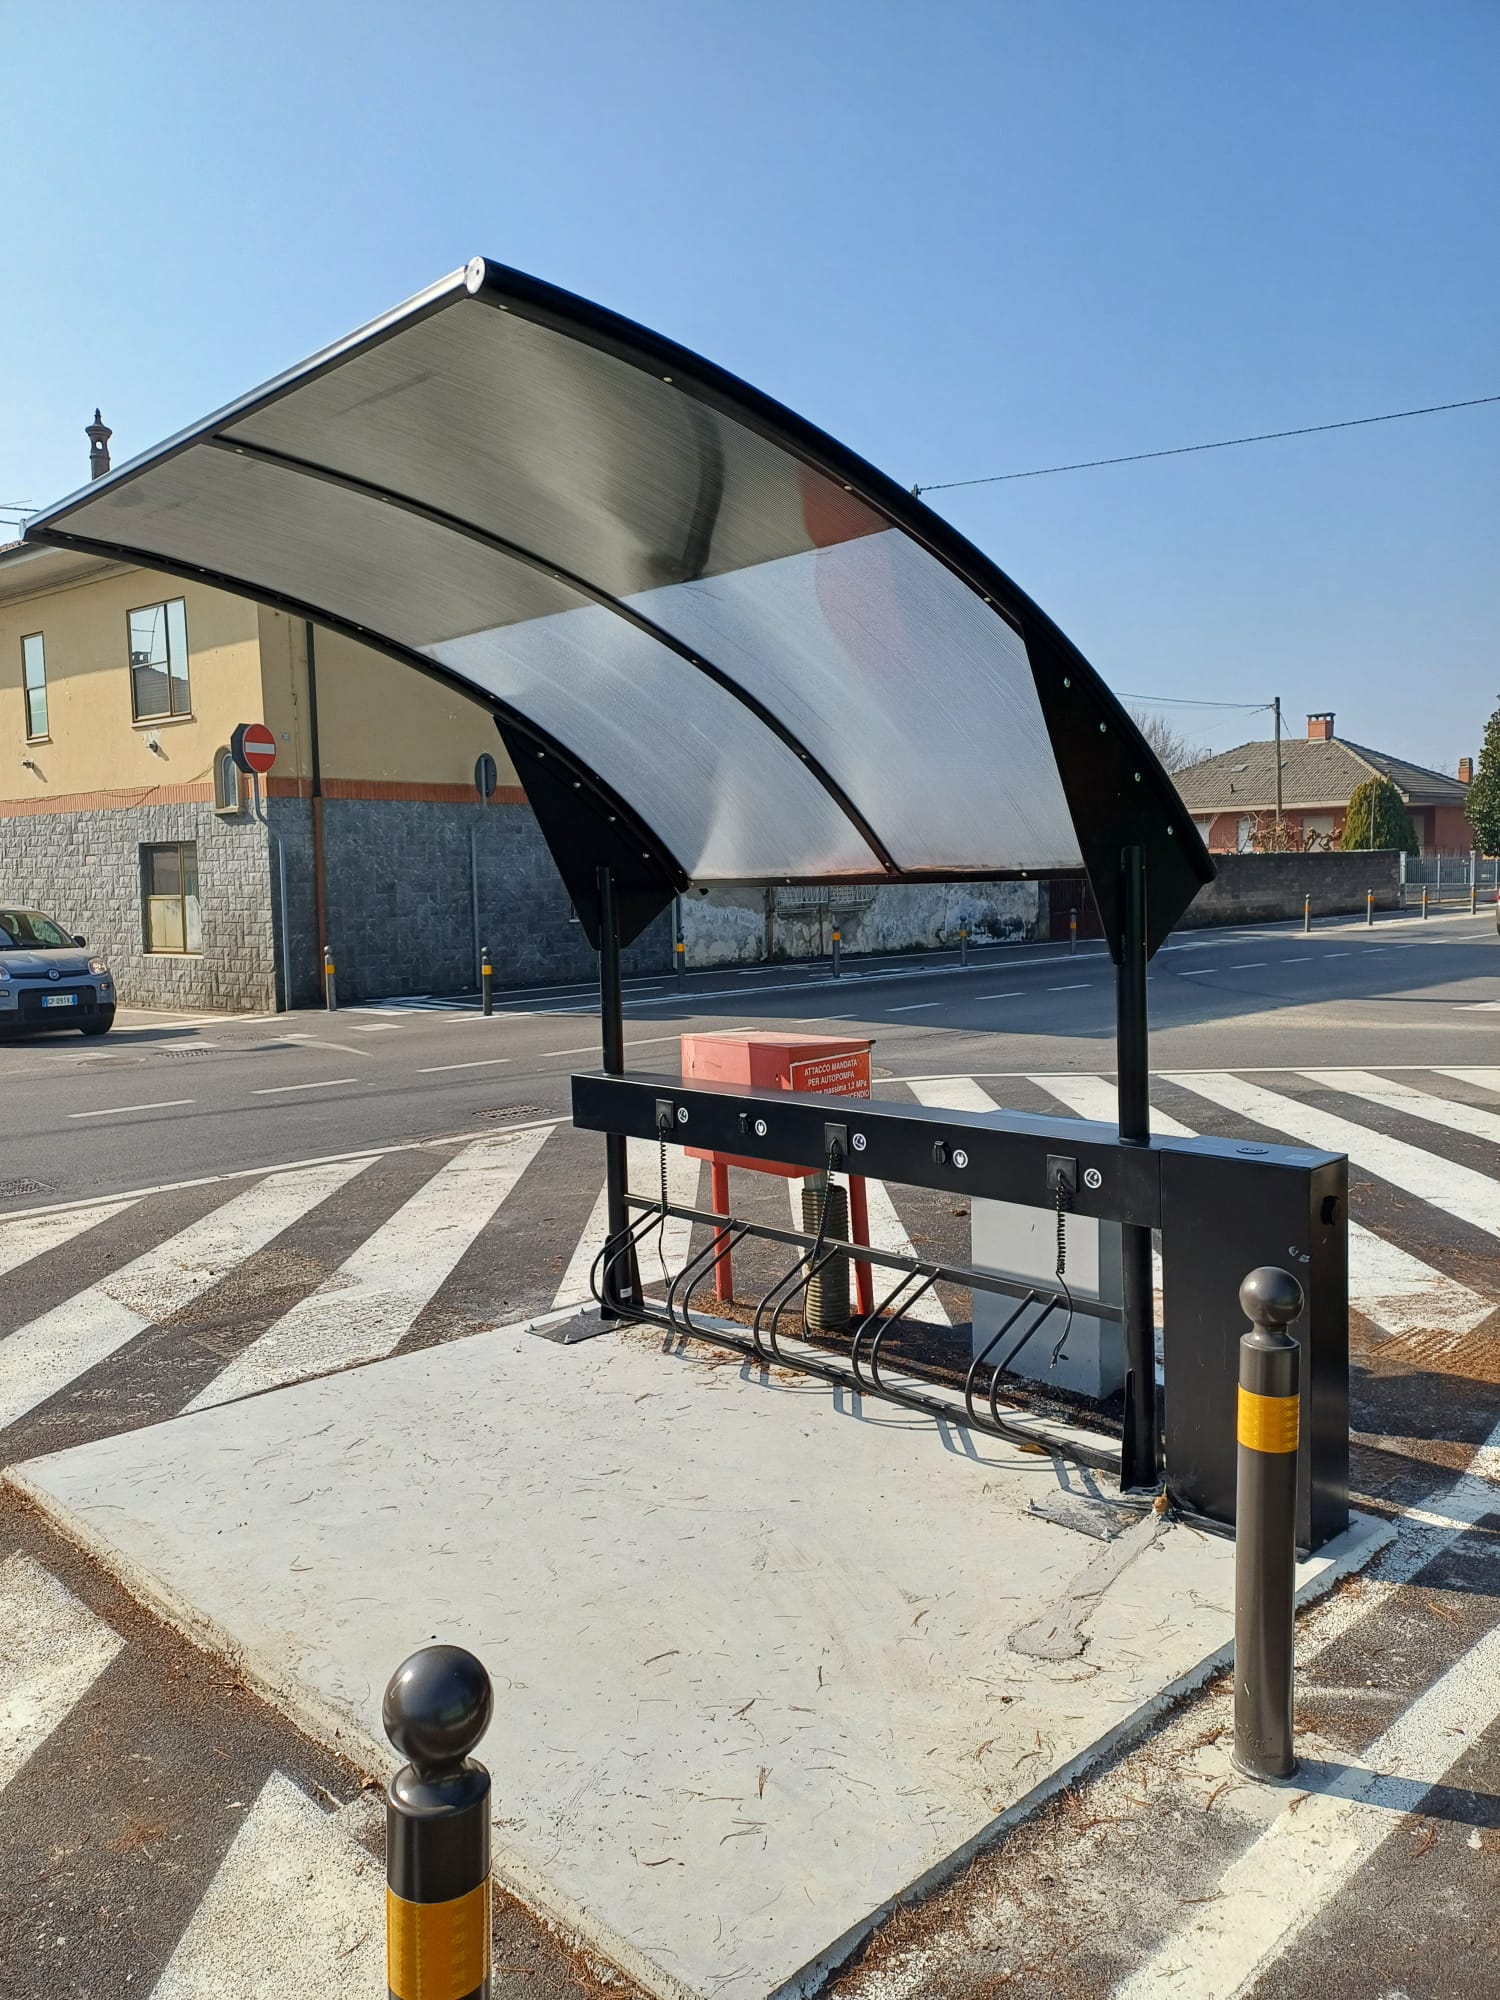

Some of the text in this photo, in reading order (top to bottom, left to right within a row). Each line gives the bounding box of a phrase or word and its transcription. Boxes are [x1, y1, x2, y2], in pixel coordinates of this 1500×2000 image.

[804, 1059, 858, 1076] ATTACCO MANDATA
[808, 1070, 855, 1087] PER AUTOPOMPA
